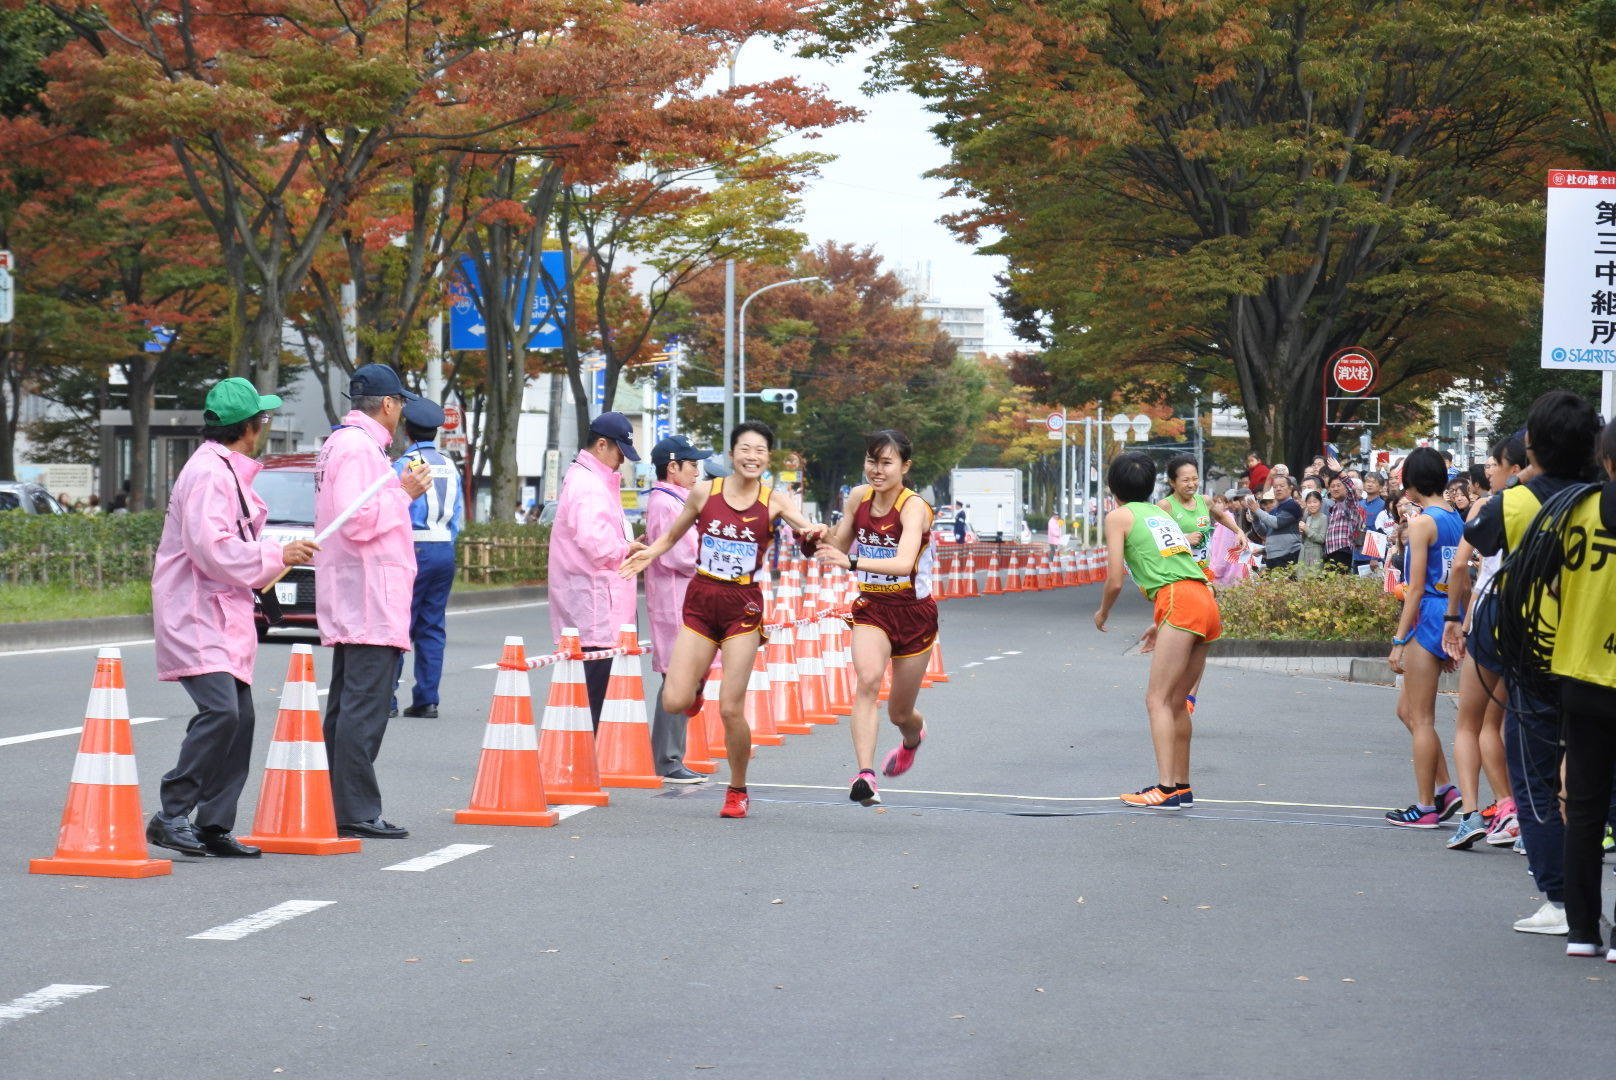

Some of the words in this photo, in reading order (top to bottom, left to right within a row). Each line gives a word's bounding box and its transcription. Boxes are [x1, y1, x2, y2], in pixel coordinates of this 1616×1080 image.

[1338, 366, 1369, 381] 消火栓
[706, 519, 756, 542] 名城大
[857, 527, 898, 547] 名城大
[865, 547, 898, 559] START
[864, 584, 901, 592] SEIKO
